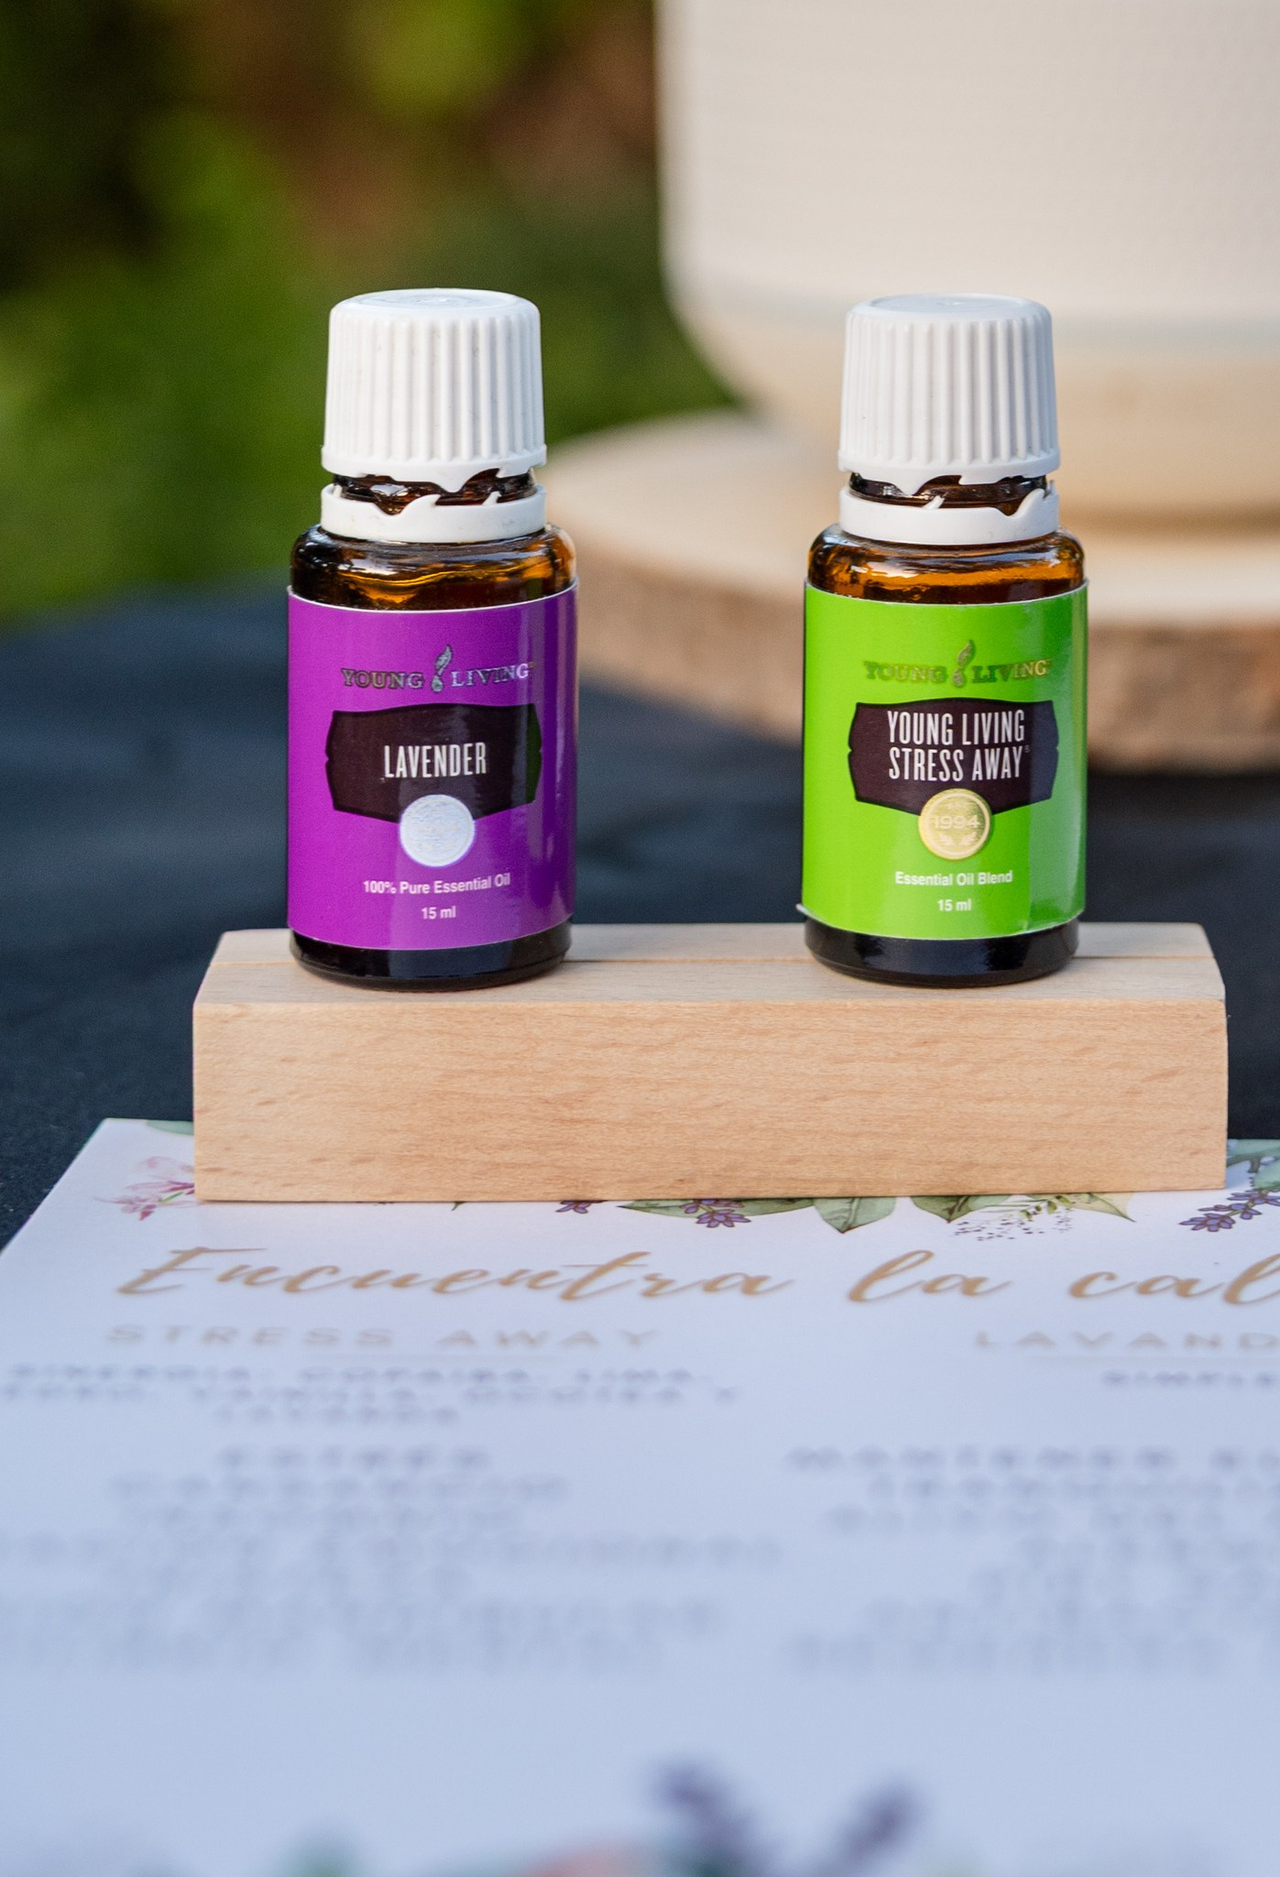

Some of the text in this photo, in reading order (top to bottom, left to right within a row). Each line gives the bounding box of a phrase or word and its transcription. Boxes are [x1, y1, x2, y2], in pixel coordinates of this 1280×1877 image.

[341, 662, 530, 689] YOUNG LIVING
[864, 659, 1049, 683] YOUNG LIVING
[887, 709, 1025, 745] YOUNG LIVING
[384, 741, 487, 778] LAVENDER
[888, 746, 1024, 782] STRESS AWAY
[934, 814, 981, 830] 1994
[363, 872, 512, 895] 100% Pure Essential Oil
[895, 870, 1014, 887] Essential Oil Blend
[421, 905, 457, 920] 15 ml
[938, 898, 972, 912] 15 ml
[115, 1245, 797, 1302] Encuentra
[846, 1249, 1012, 1306] la
[104, 1325, 661, 1350] STRESS AWAY
